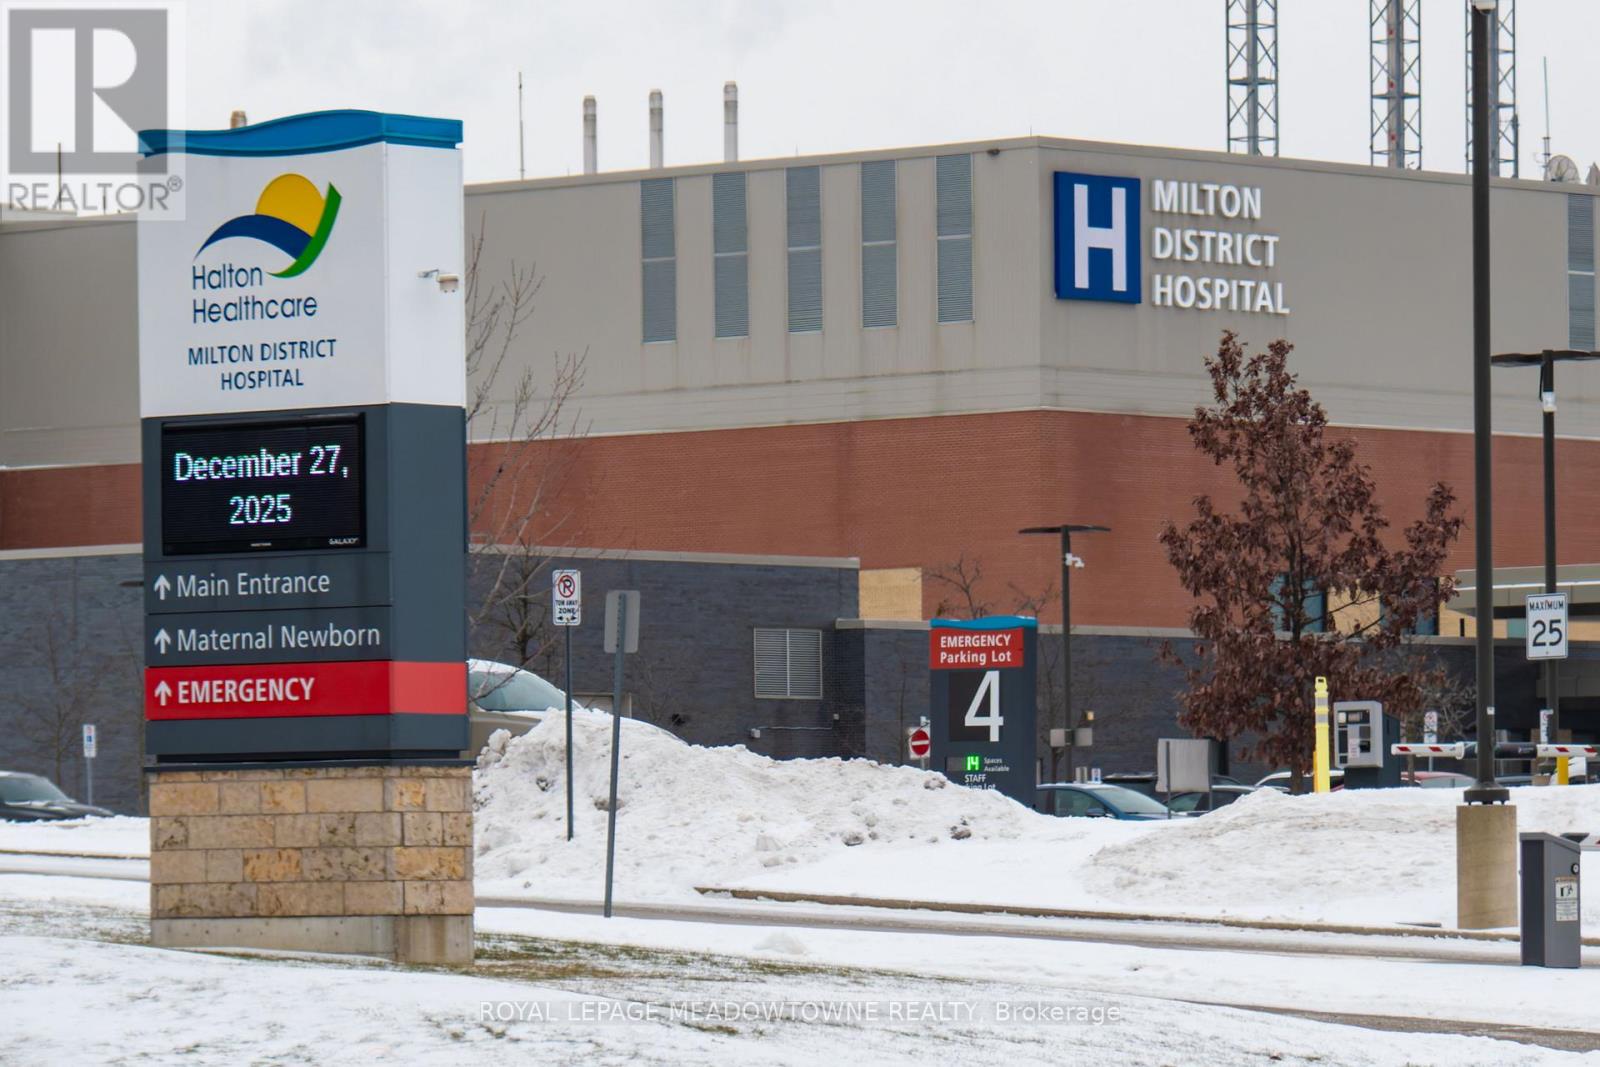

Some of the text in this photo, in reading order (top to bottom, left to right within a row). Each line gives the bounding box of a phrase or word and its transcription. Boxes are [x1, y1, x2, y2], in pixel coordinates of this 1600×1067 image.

[1152, 179, 1262, 220] MILTON
[1073, 183, 1127, 292] H
[1152, 227, 1279, 268] DISTRICT
[192, 263, 263, 291] Halton
[1152, 274, 1290, 315] HOSPITAL
[193, 295, 317, 325] Healthcare
[188, 338, 337, 366] MILTON DISTRICT
[221, 368, 304, 391] HOSPITAL
[174, 444, 349, 481] December 27,
[229, 494, 293, 525] 2025
[177, 572, 330, 598] Main Entrance
[558, 607, 575, 615] ZONE
[1529, 600, 1564, 610] MAXIMUM
[178, 622, 381, 652] Maternal Newborn
[940, 634, 1012, 648] EMERGENCY
[1532, 619, 1563, 647] 25
[940, 650, 1012, 666] Parking Lot
[177, 677, 315, 705] EMERGENCY
[964, 670, 1004, 742] 4
[966, 755, 980, 771] 14
[964, 773, 987, 783] STAFF
